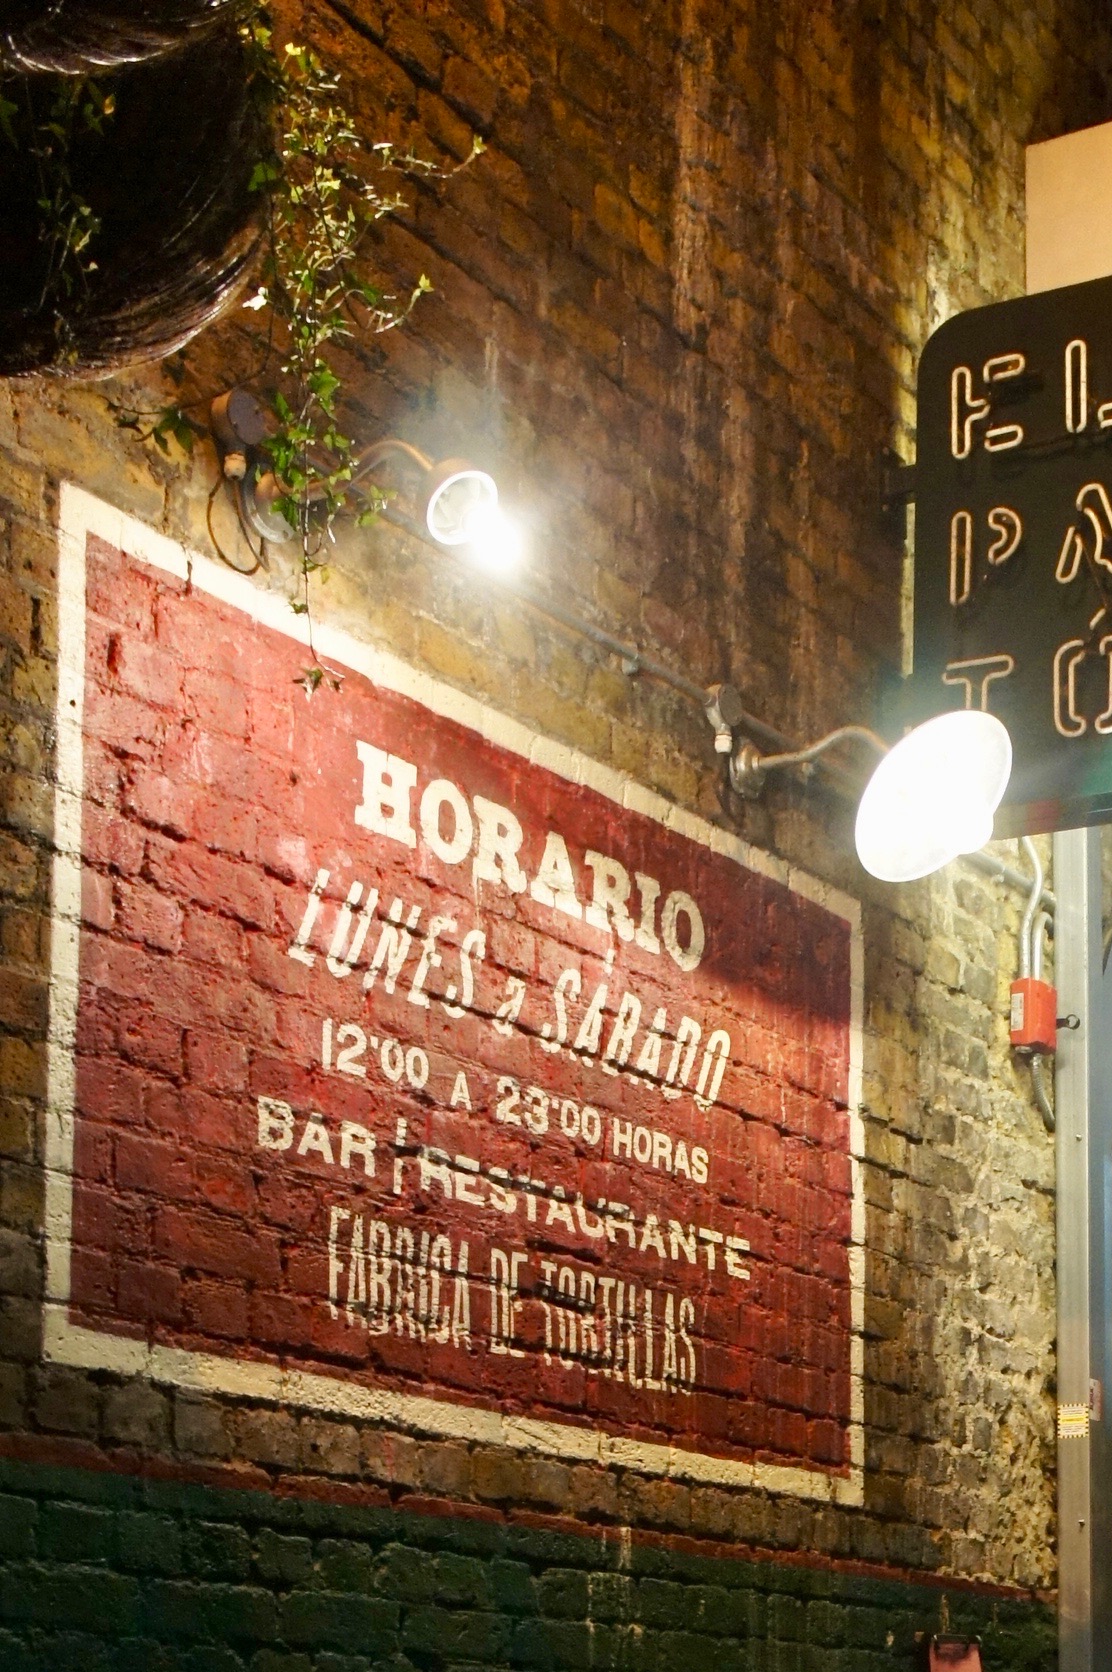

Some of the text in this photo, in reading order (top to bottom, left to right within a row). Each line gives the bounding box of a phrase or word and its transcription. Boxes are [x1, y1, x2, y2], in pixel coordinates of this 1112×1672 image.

[287, 867, 487, 1019] LUNES
[355, 739, 706, 973] HORARIO
[256, 1095, 377, 1178] BAR
[416, 1145, 751, 1281] RESTAURANTE
[450, 1070, 473, 1111] A
[612, 1117, 710, 1185] HORAS
[327, 1205, 697, 1397] FABRICA DE TORTILLAS
